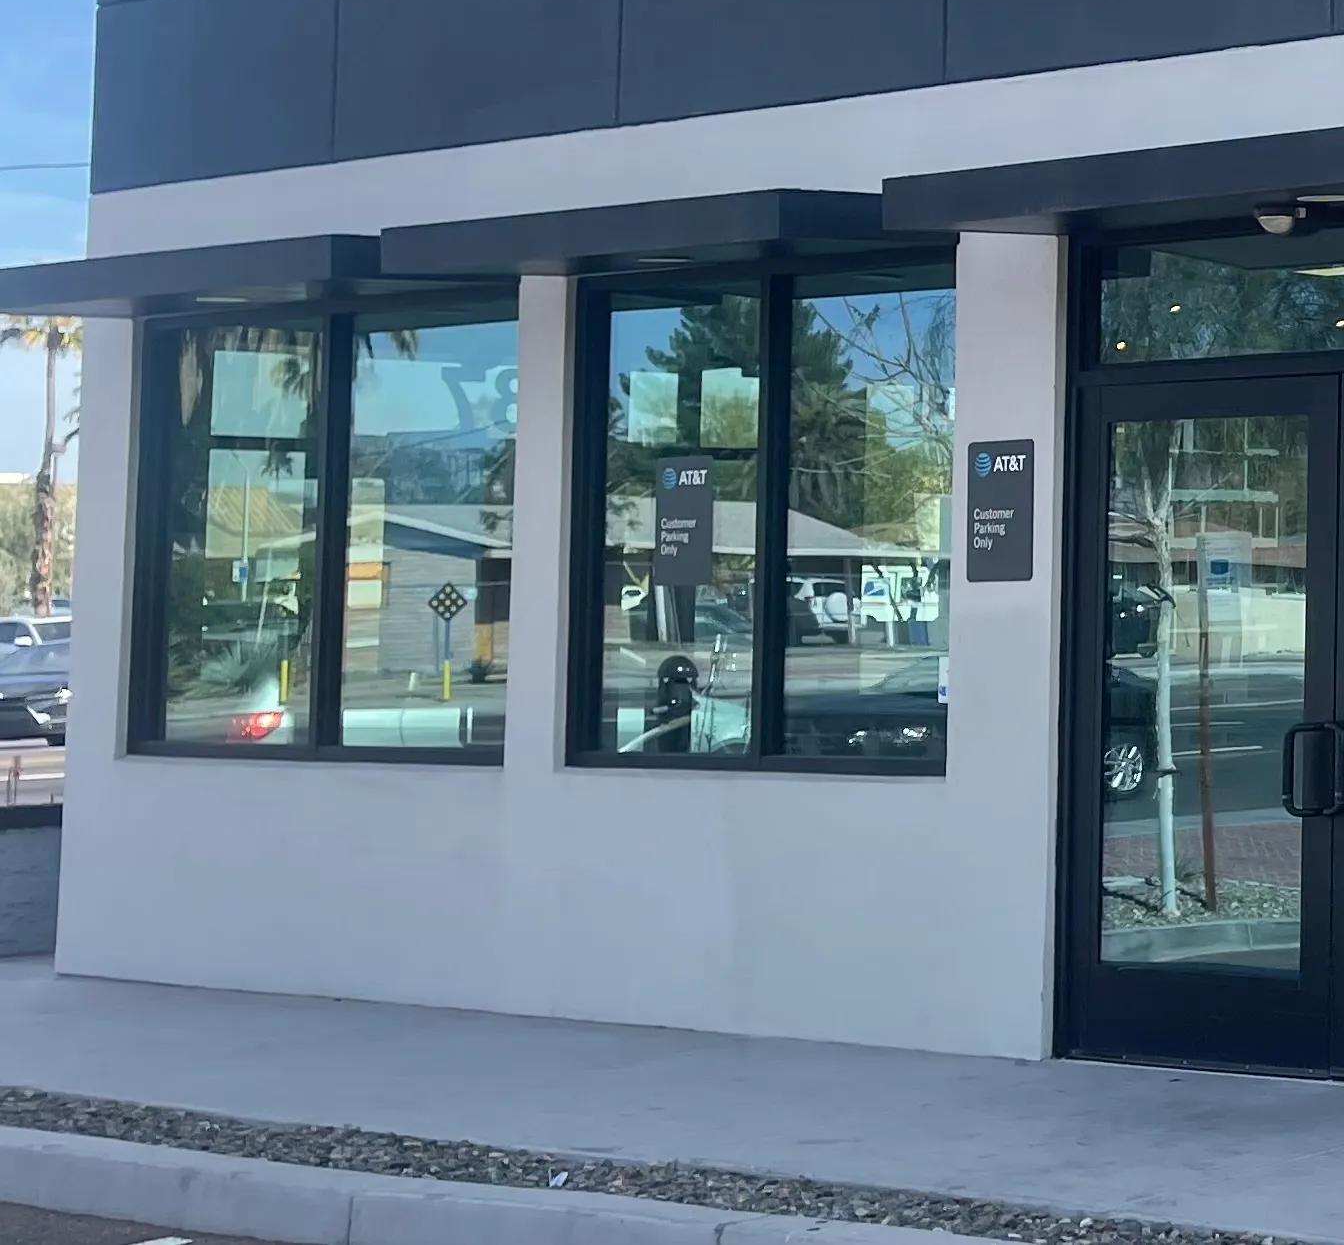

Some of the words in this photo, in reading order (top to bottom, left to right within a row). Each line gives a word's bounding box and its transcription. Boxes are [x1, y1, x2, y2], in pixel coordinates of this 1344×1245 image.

[993, 454, 1027, 472] AT&T
[678, 469, 708, 486] AT&T
[973, 508, 1015, 520] Customer
[660, 518, 697, 529] Customer
[973, 522, 1006, 536] Parking
[660, 531, 689, 543] Parking
[973, 536, 994, 551] Only
[660, 544, 679, 557] Only
